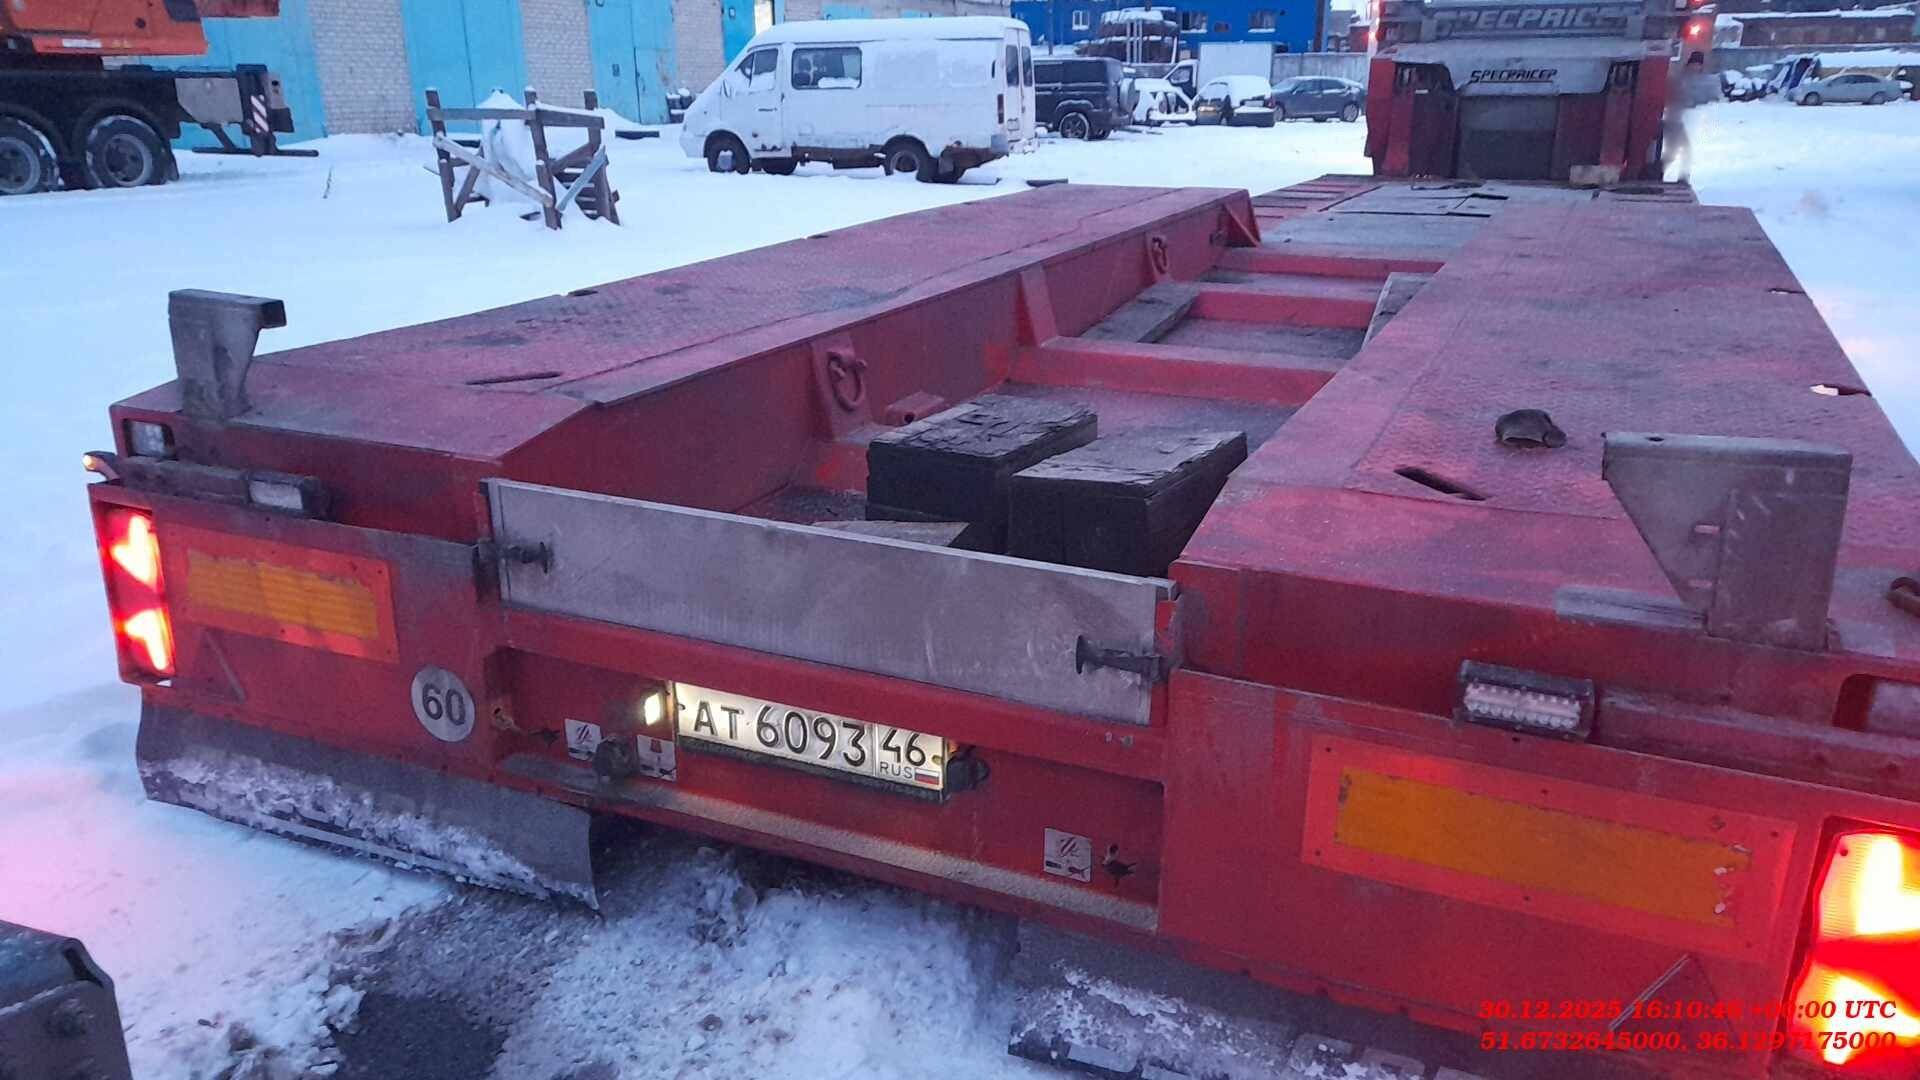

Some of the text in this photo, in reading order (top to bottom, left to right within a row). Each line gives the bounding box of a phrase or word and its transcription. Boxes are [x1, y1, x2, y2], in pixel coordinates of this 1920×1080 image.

[421, 683, 466, 726] 60
[693, 699, 926, 767] AT 6093 46
[880, 761, 913, 779] RUS
